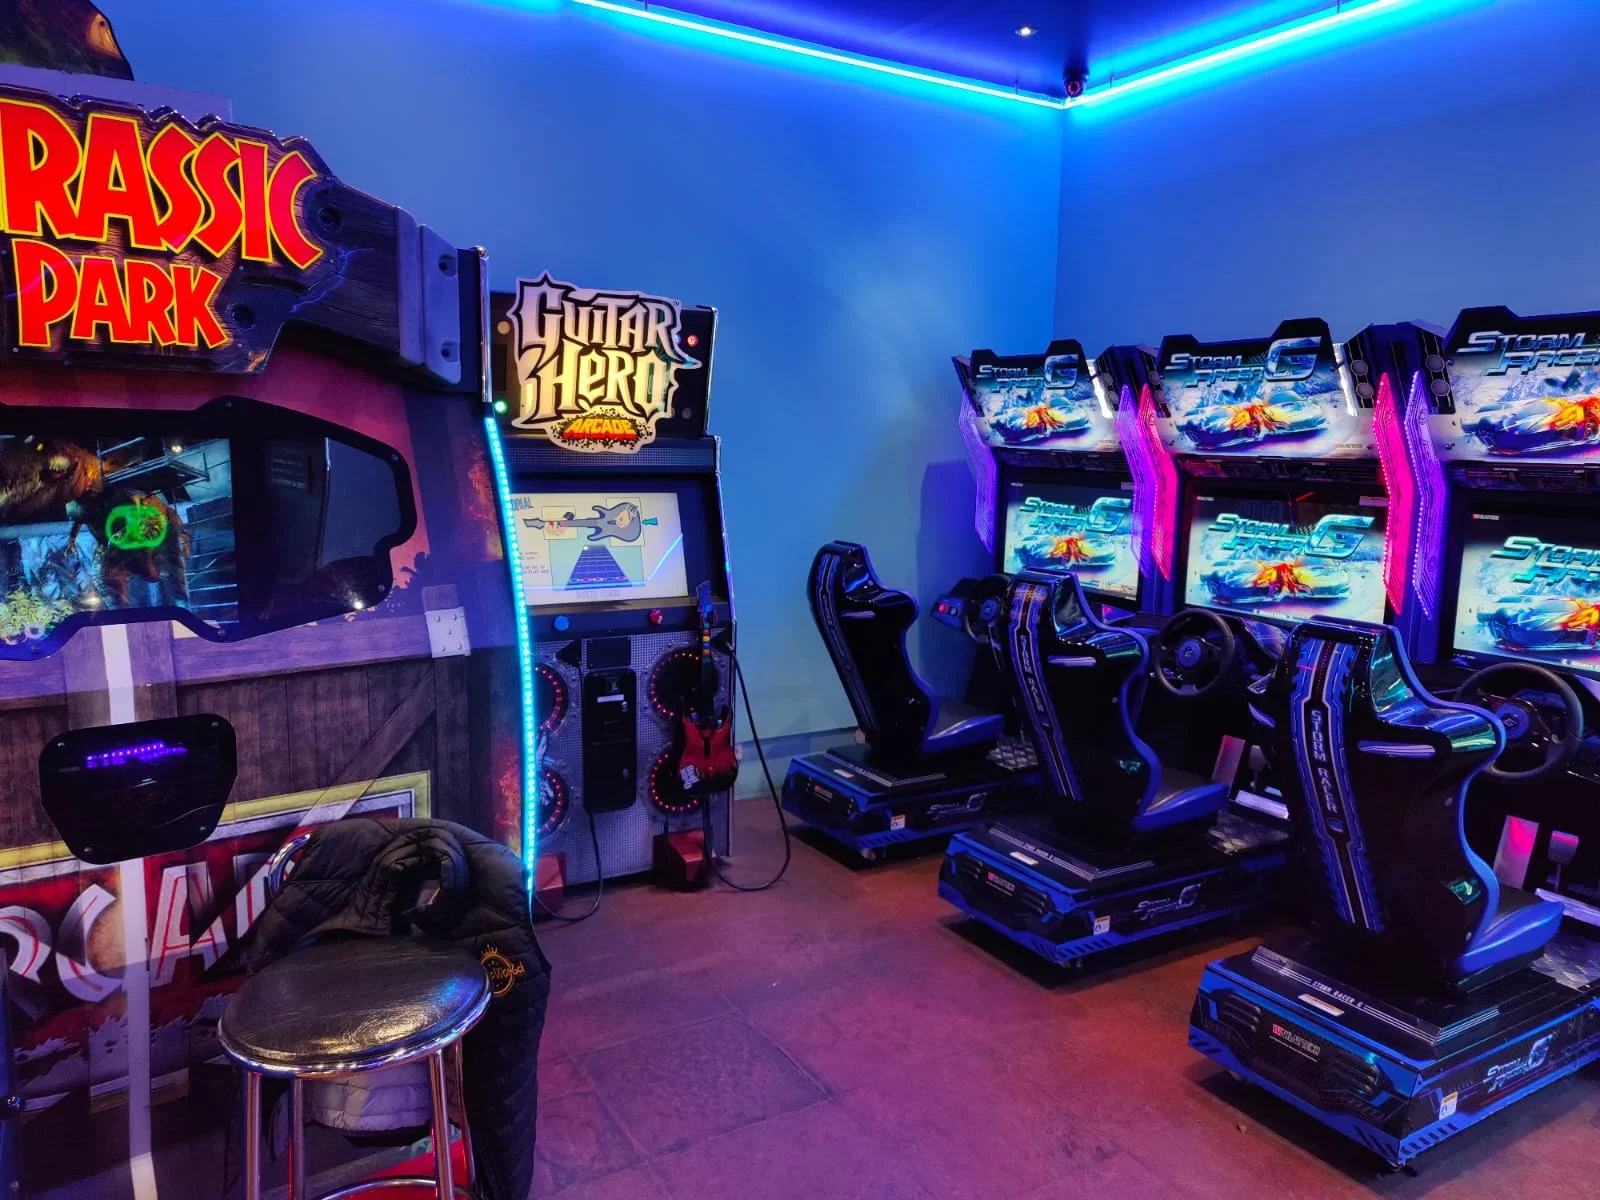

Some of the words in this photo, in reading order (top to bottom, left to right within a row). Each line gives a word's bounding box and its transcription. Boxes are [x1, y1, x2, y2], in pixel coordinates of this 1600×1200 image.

[13, 239, 228, 349] PARK
[519, 282, 691, 367] GUITAR
[1456, 330, 1586, 352] STORM
[976, 364, 1028, 378] STORM
[1043, 353, 1079, 389] G
[1165, 353, 1242, 371] STORM
[1184, 366, 1264, 388] RACER
[1264, 336, 1322, 381] G
[562, 418, 639, 440] ARCADE
[1019, 496, 1076, 514] STORM
[1085, 497, 1132, 532] G
[1208, 513, 1290, 536] STORM
[1221, 534, 1306, 552] RACER
[1304, 513, 1375, 558] G
[1311, 709, 1327, 761] STORM
